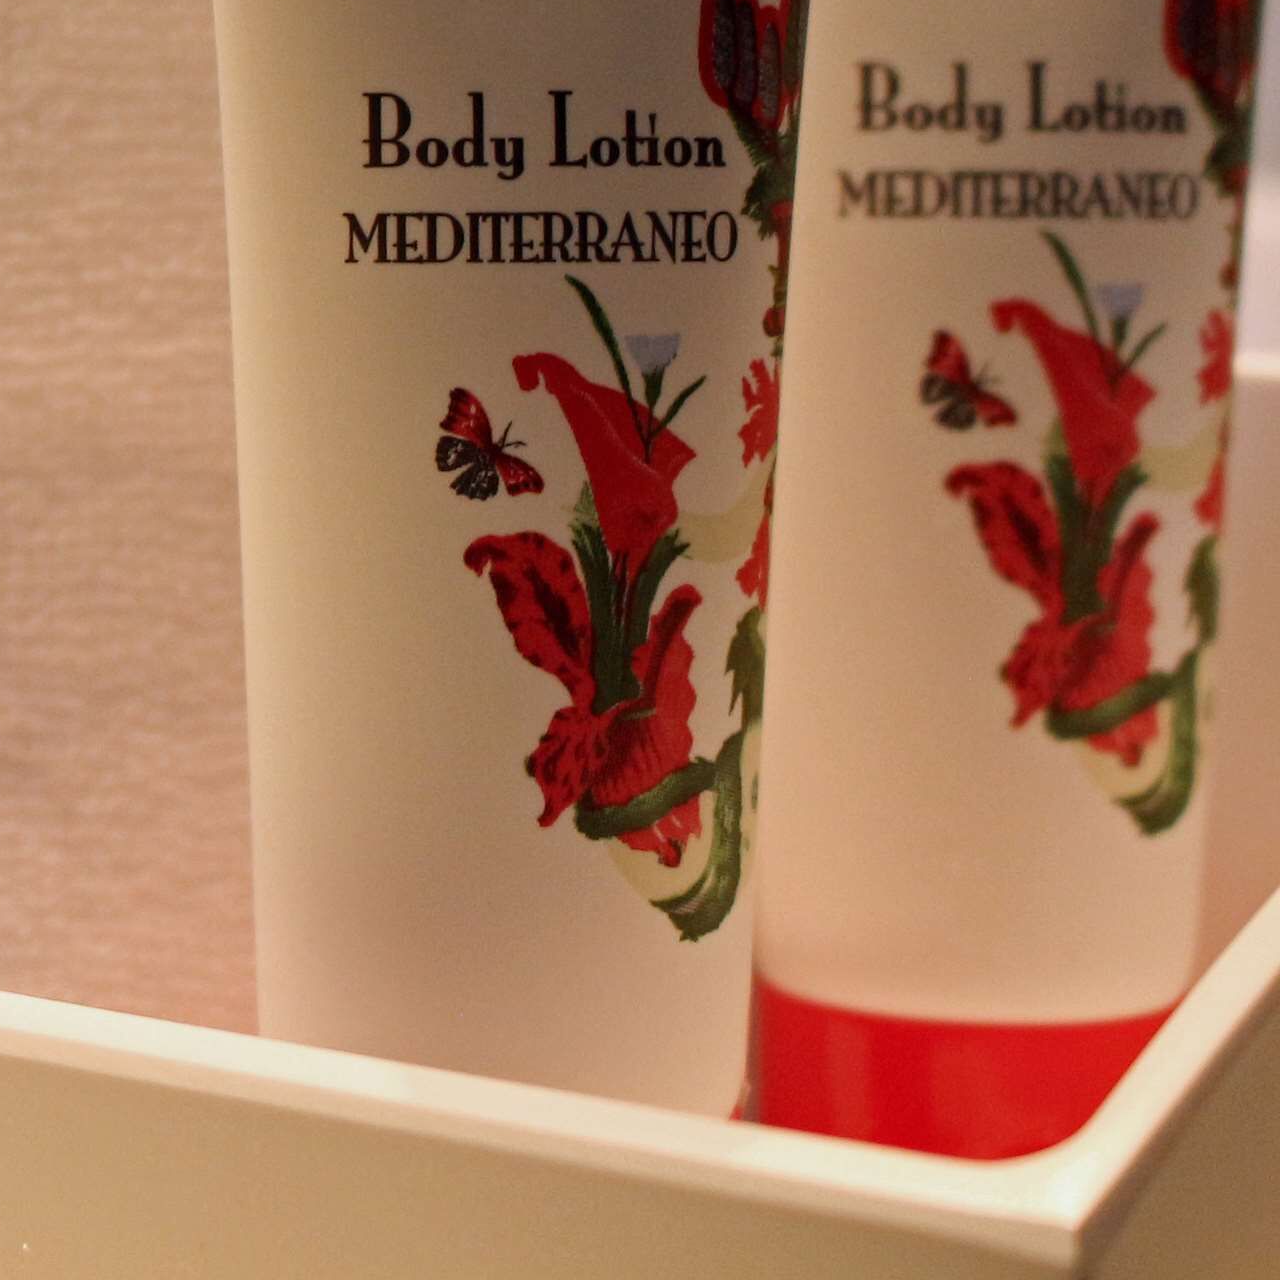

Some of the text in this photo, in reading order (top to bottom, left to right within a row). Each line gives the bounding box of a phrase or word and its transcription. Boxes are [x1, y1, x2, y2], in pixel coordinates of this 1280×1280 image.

[361, 90, 727, 180] Body Lotion
[855, 59, 1190, 145] Body Lotion
[836, 169, 1199, 222] MEDITERRANEO
[344, 211, 739, 265] MEDITERRANEO
